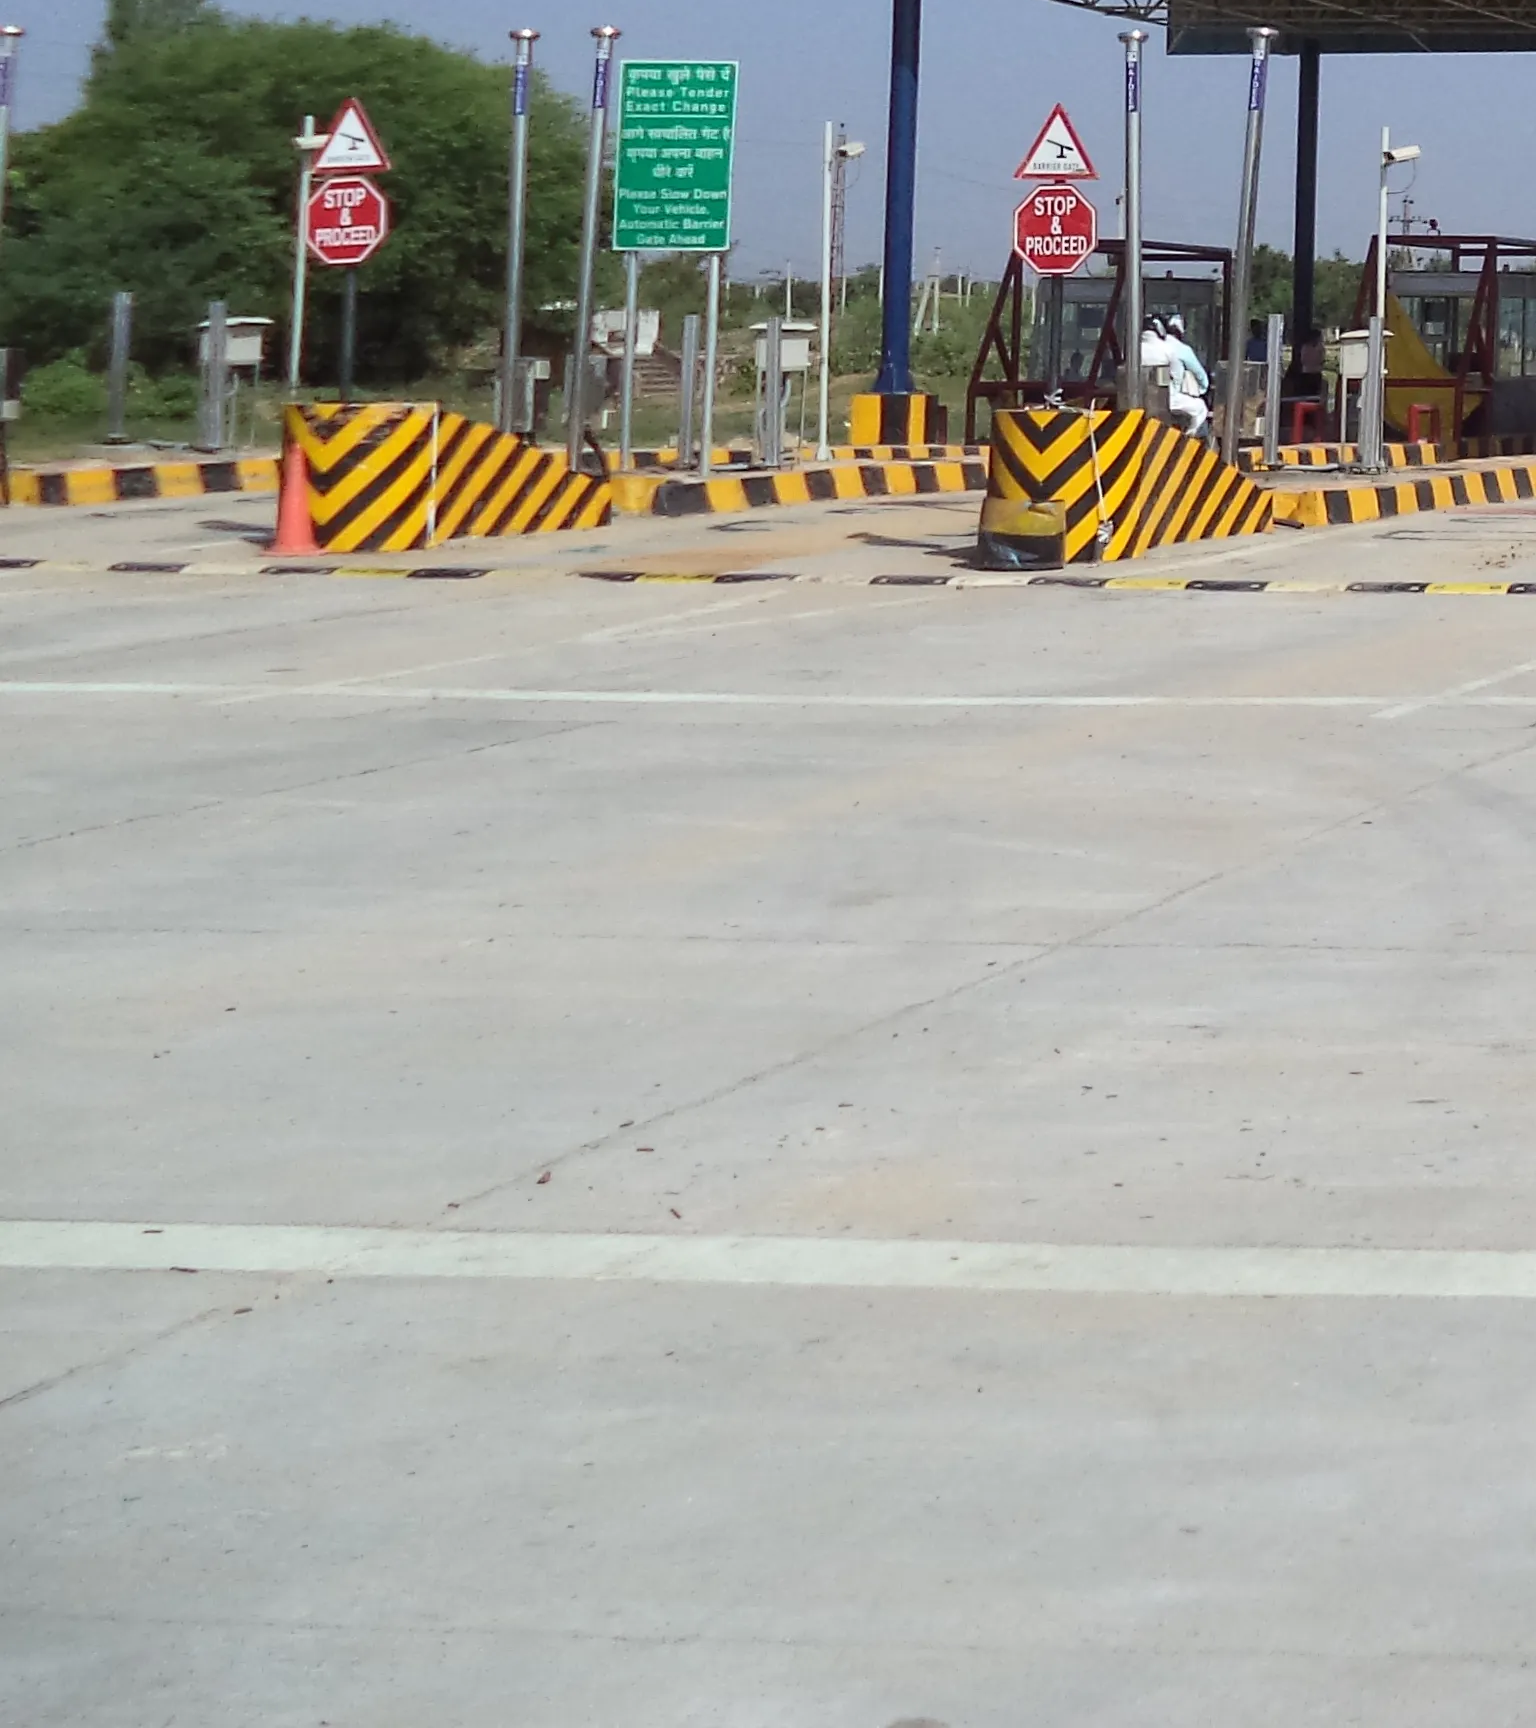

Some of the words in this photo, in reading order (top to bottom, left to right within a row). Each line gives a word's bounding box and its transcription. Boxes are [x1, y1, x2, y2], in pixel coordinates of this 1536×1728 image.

[680, 86, 729, 98] Tender
[626, 100, 665, 112] Exact
[672, 100, 726, 114] Change
[323, 188, 366, 209] STOP
[1034, 196, 1077, 216] STOP
[1050, 215, 1062, 235] &
[1025, 236, 1087, 256] PROCEED
